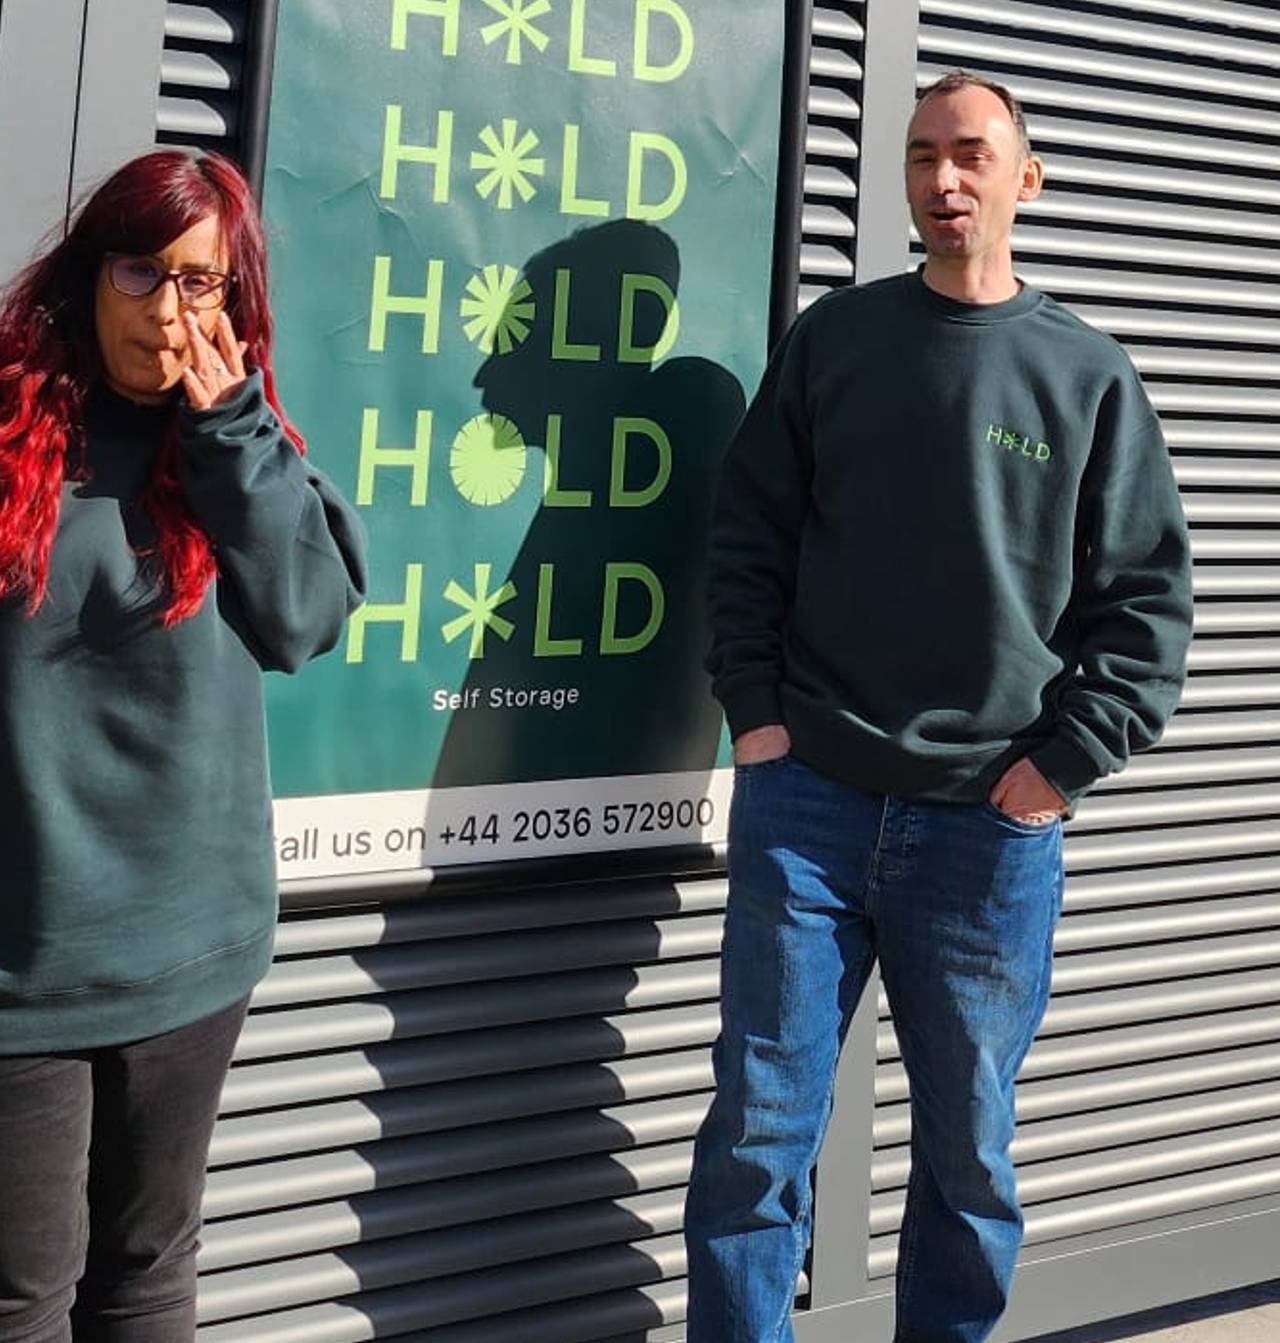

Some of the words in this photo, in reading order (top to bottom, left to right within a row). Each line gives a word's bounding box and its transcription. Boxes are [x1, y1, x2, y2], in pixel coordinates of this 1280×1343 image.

[432, 688, 481, 711] Self
[489, 687, 580, 711] Storage
[273, 827, 318, 863] all
[331, 830, 372, 857] us
[384, 826, 427, 853] on
[439, 813, 501, 847] +44
[512, 806, 592, 844] 2036
[602, 796, 715, 835] 572900
